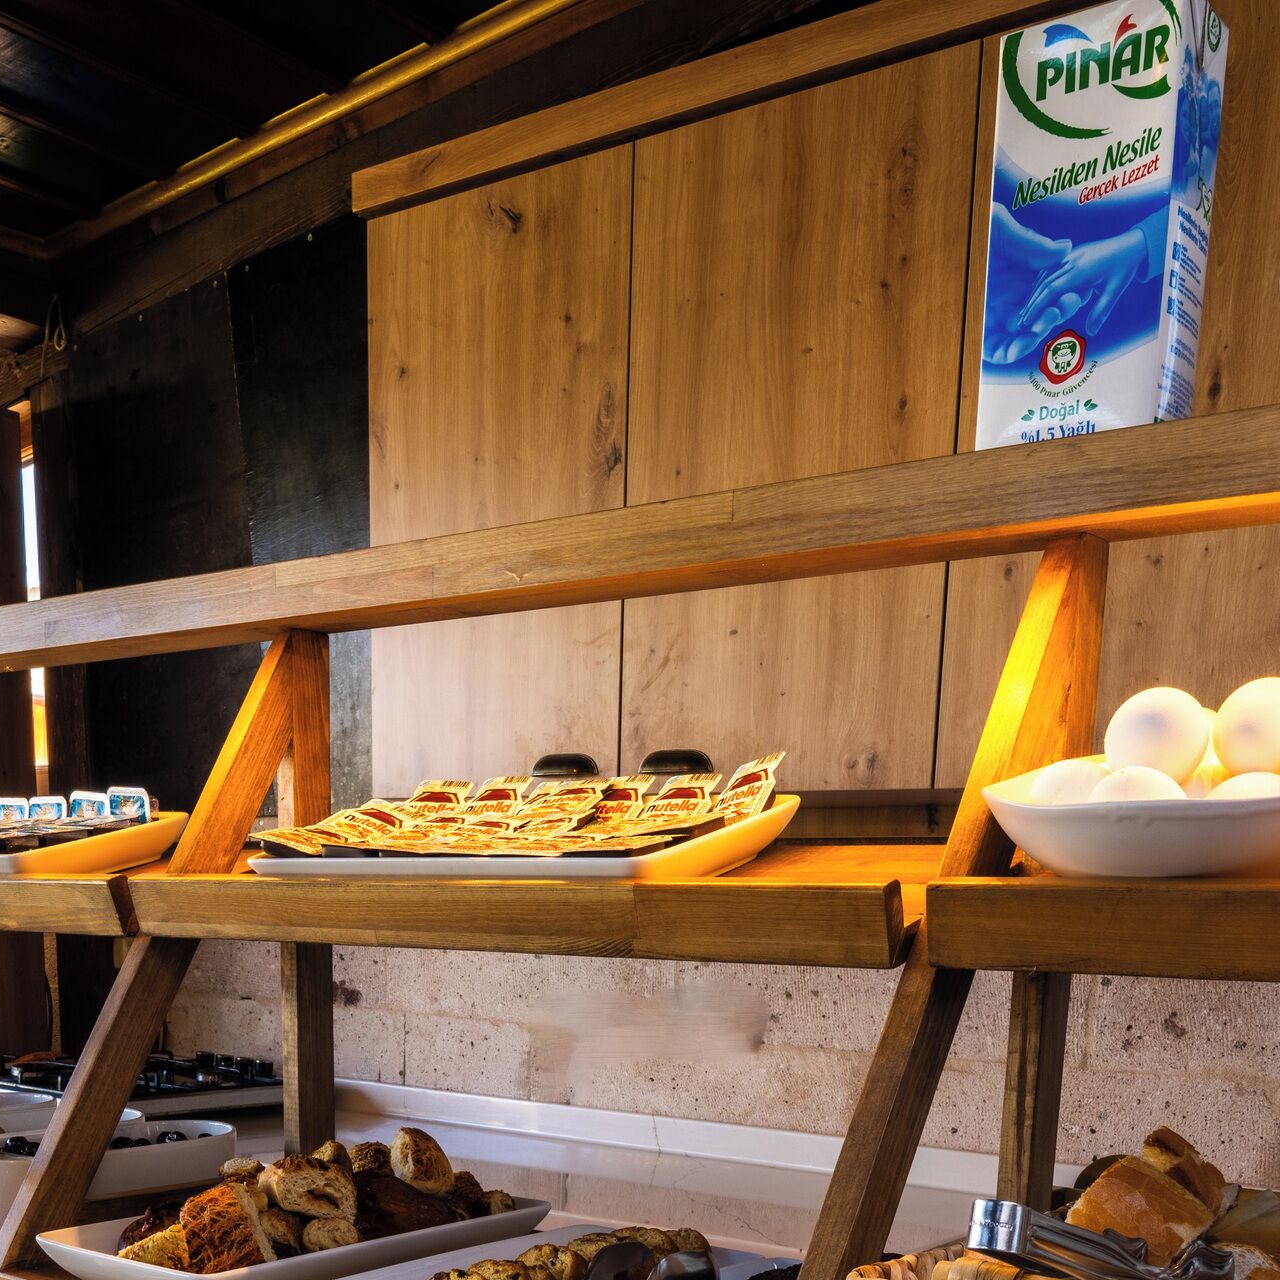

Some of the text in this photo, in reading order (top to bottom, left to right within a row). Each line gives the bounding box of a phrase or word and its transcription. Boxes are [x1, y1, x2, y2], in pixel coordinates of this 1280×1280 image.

[1035, 24, 1171, 102] PINAR
[1013, 127, 1163, 209] Nesilden Nesile
[1078, 154, 1160, 205] Gerçek Lezzet
[1062, 360, 1098, 396] Güvencesi
[1039, 400, 1080, 421] Doğal
[1059, 420, 1096, 438] Yağlı
[465, 801, 512, 813] nutella
[646, 800, 698, 813] nutella
[716, 784, 763, 808] nutella
[344, 814, 393, 836] nutella
